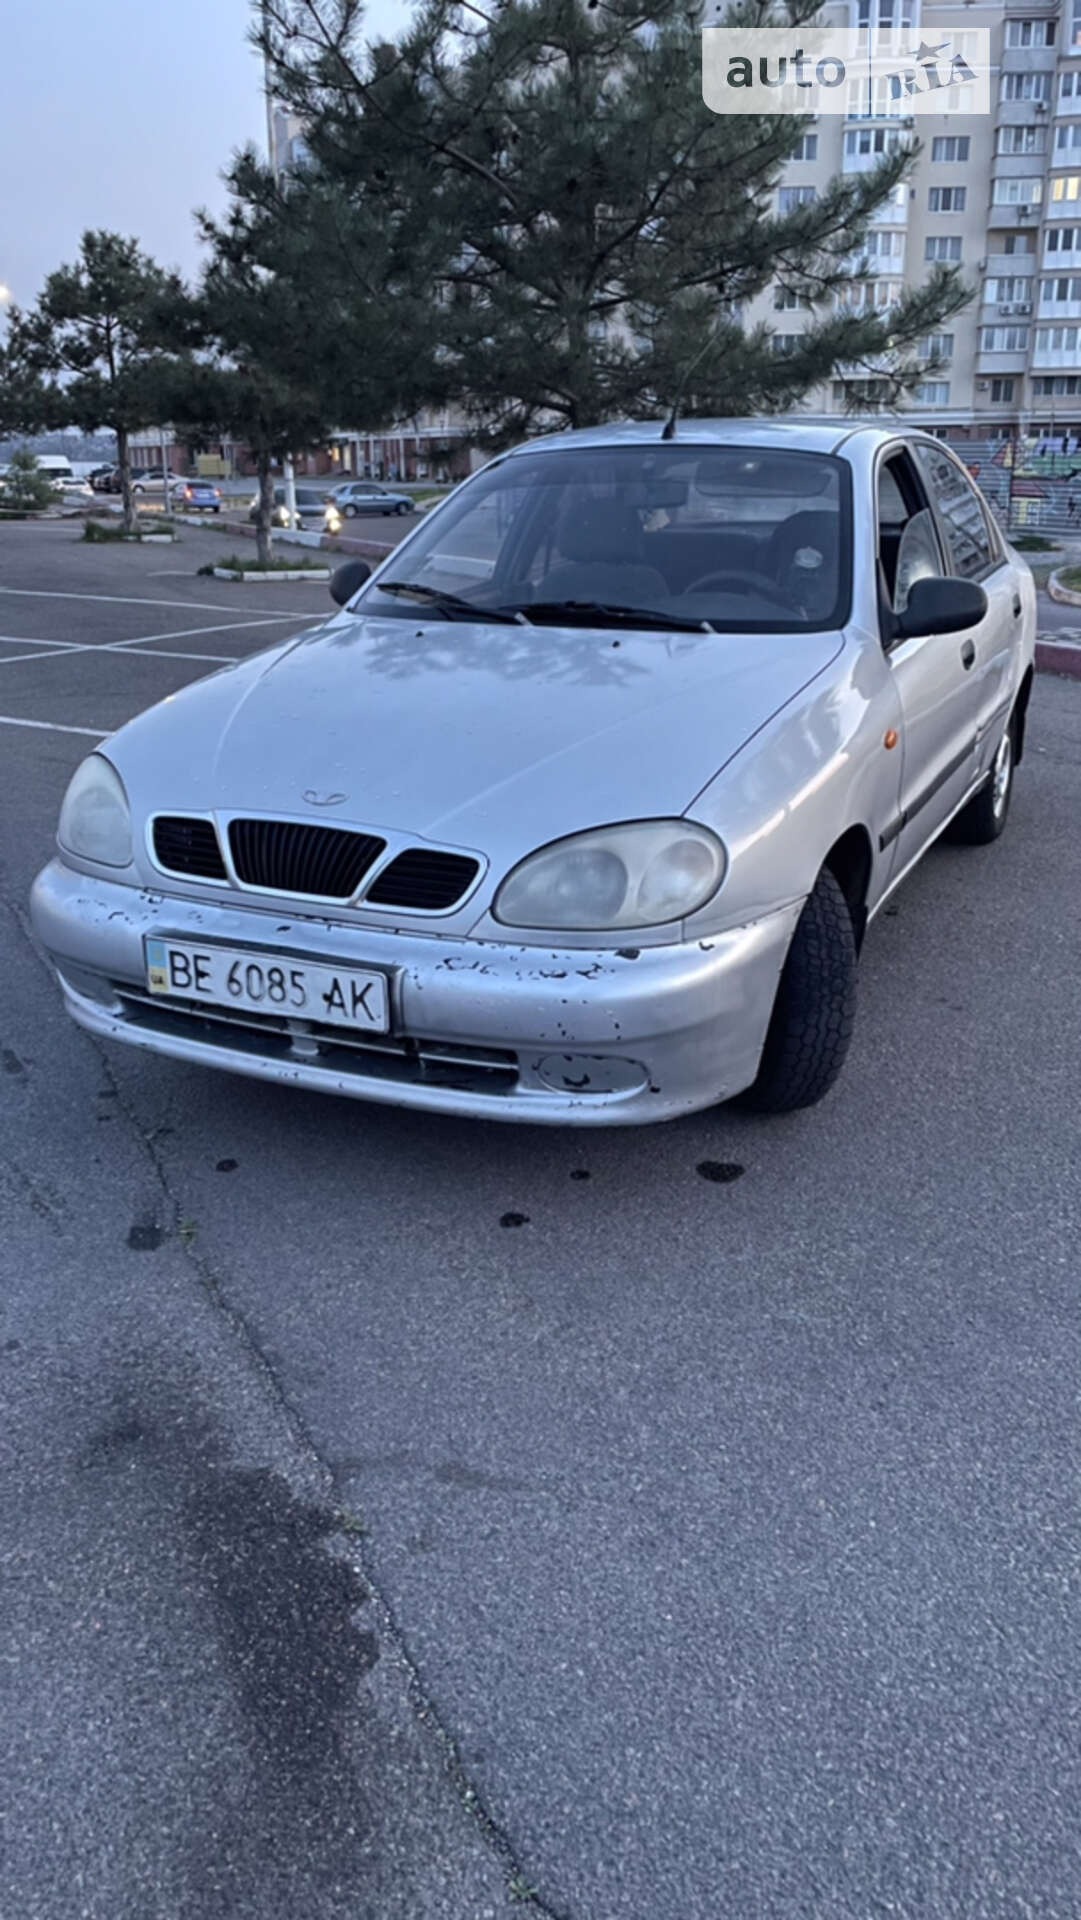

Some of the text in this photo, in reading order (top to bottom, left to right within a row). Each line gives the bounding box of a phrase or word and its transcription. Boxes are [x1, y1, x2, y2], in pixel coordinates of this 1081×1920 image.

[168, 950, 375, 1022] BE 6085 AK
